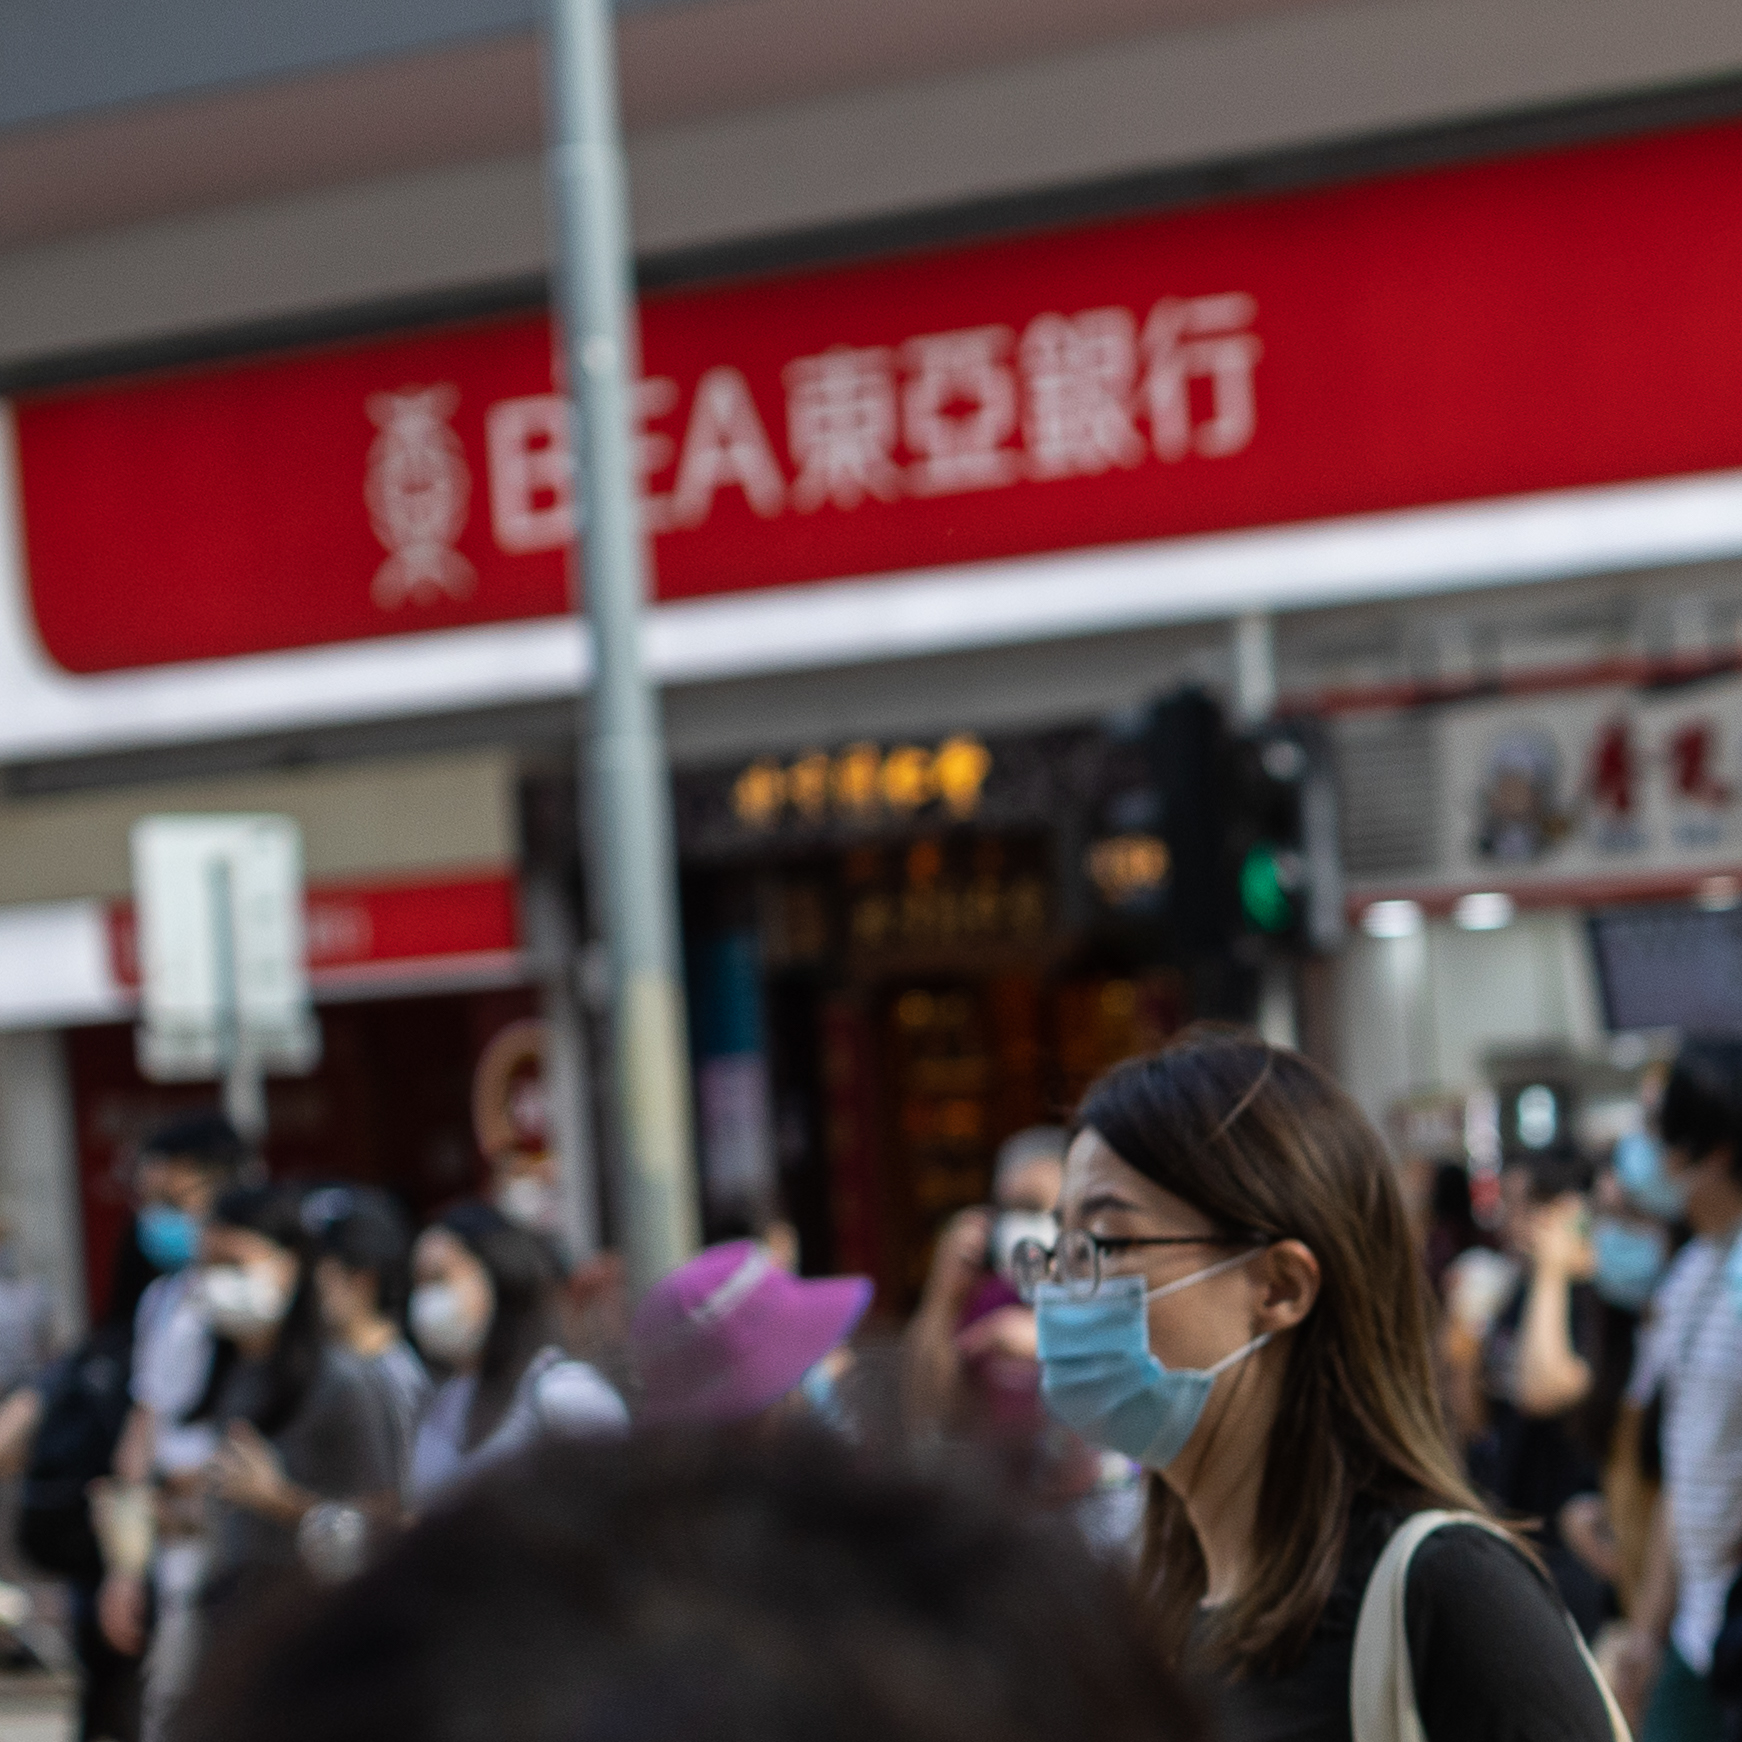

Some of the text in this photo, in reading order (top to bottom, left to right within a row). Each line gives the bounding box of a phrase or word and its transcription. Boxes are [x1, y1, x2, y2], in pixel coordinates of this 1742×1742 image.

[484, 292, 1262, 552] BEA 東亞銀行
